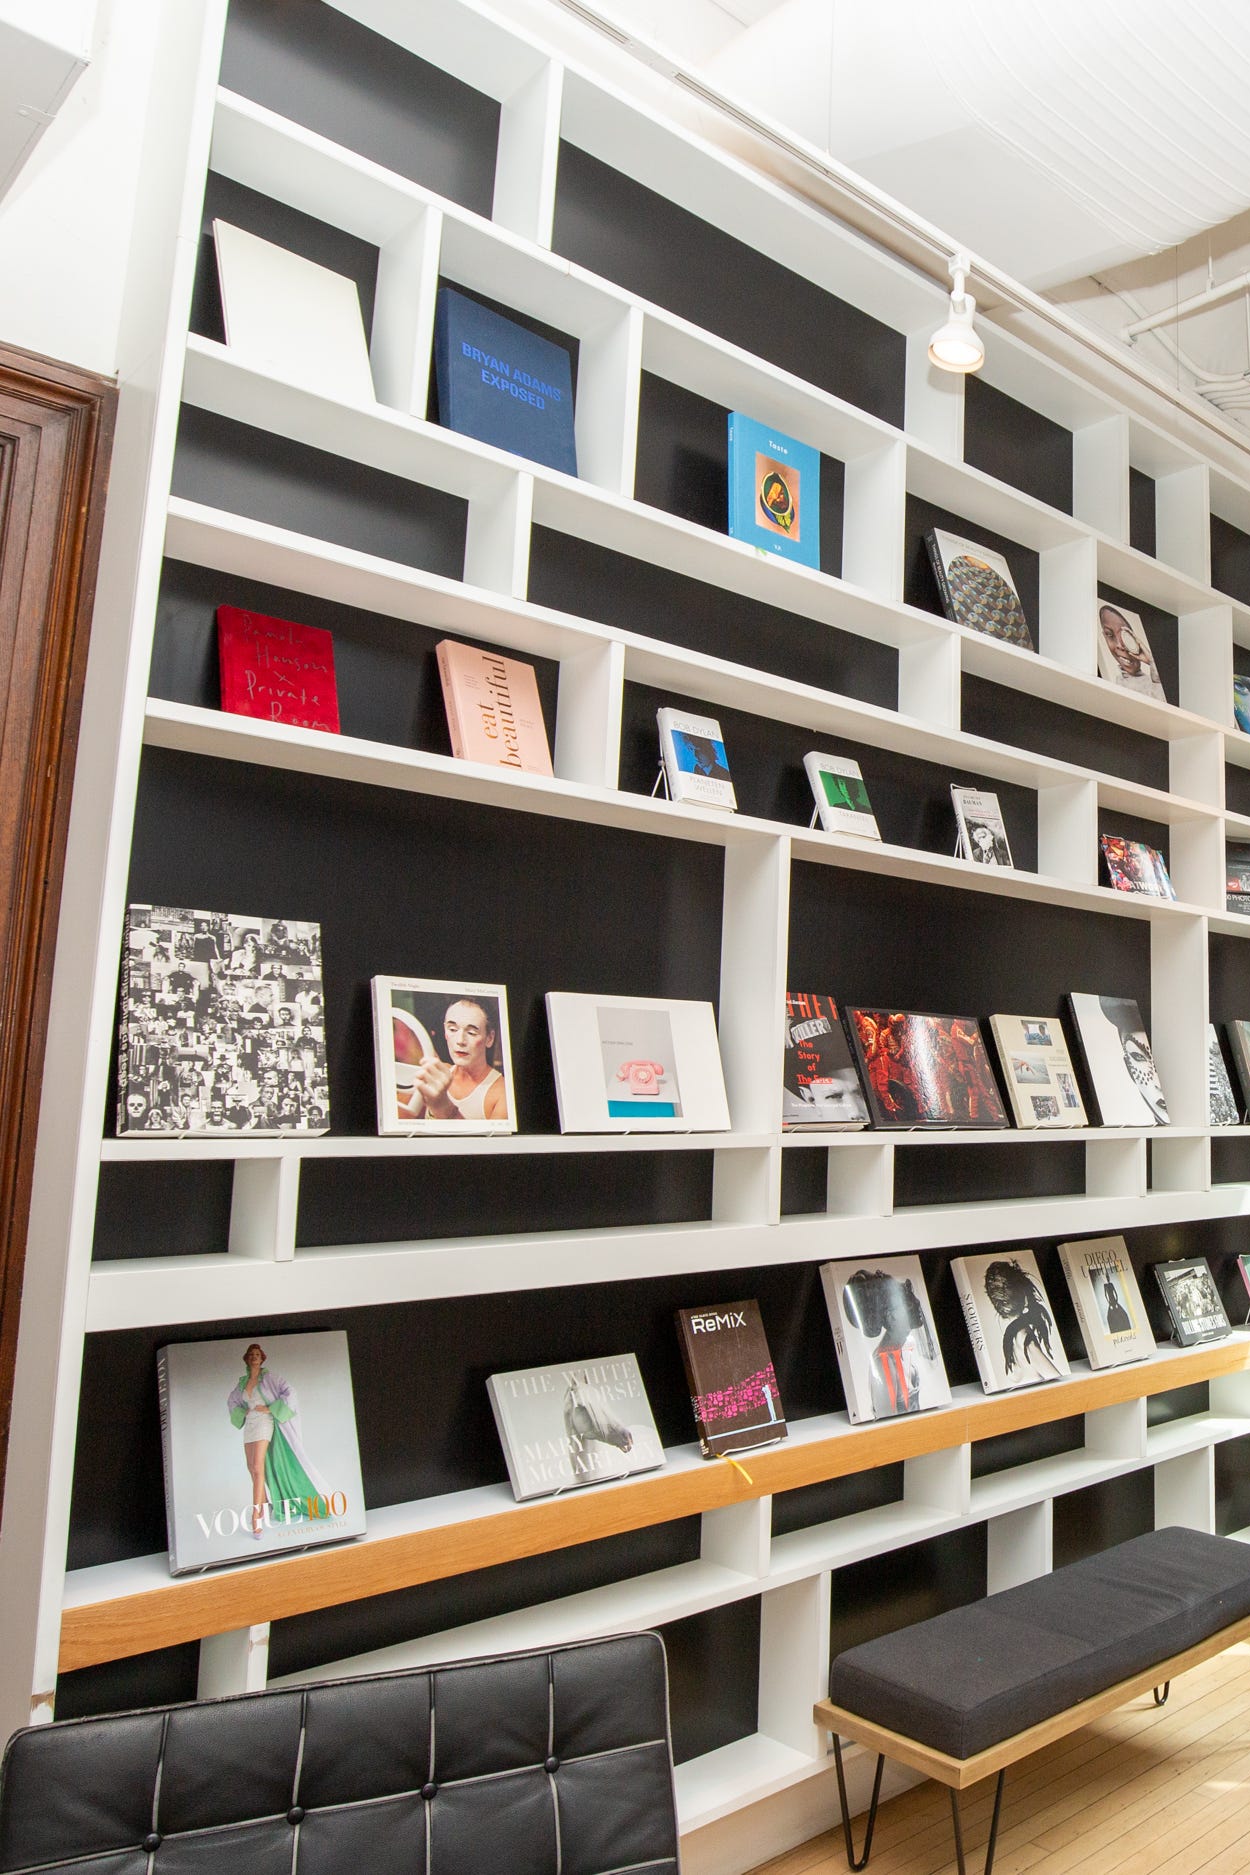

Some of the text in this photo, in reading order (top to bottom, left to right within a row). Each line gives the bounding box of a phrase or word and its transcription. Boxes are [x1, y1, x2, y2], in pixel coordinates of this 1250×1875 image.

[462, 342, 561, 401] BRYAN ADAMS
[481, 369, 545, 410] EXPOSED
[768, 440, 788, 455] Taste
[243, 613, 303, 644] Pamela
[245, 670, 320, 705] Private
[270, 701, 331, 731] Room
[477, 703, 498, 739] eat
[482, 656, 522, 768] beautiful
[798, 1052, 820, 1062] Story
[799, 1040, 813, 1048] The
[807, 1063, 816, 1071] of
[1084, 1249, 1117, 1266] DIEGO
[691, 1312, 747, 1335] ReMiX
[964, 1292, 984, 1351] STOPPERS
[504, 1361, 636, 1398] THE WHITE
[524, 1433, 584, 1464] MARY
[196, 1491, 347, 1540] VOGUE 100
